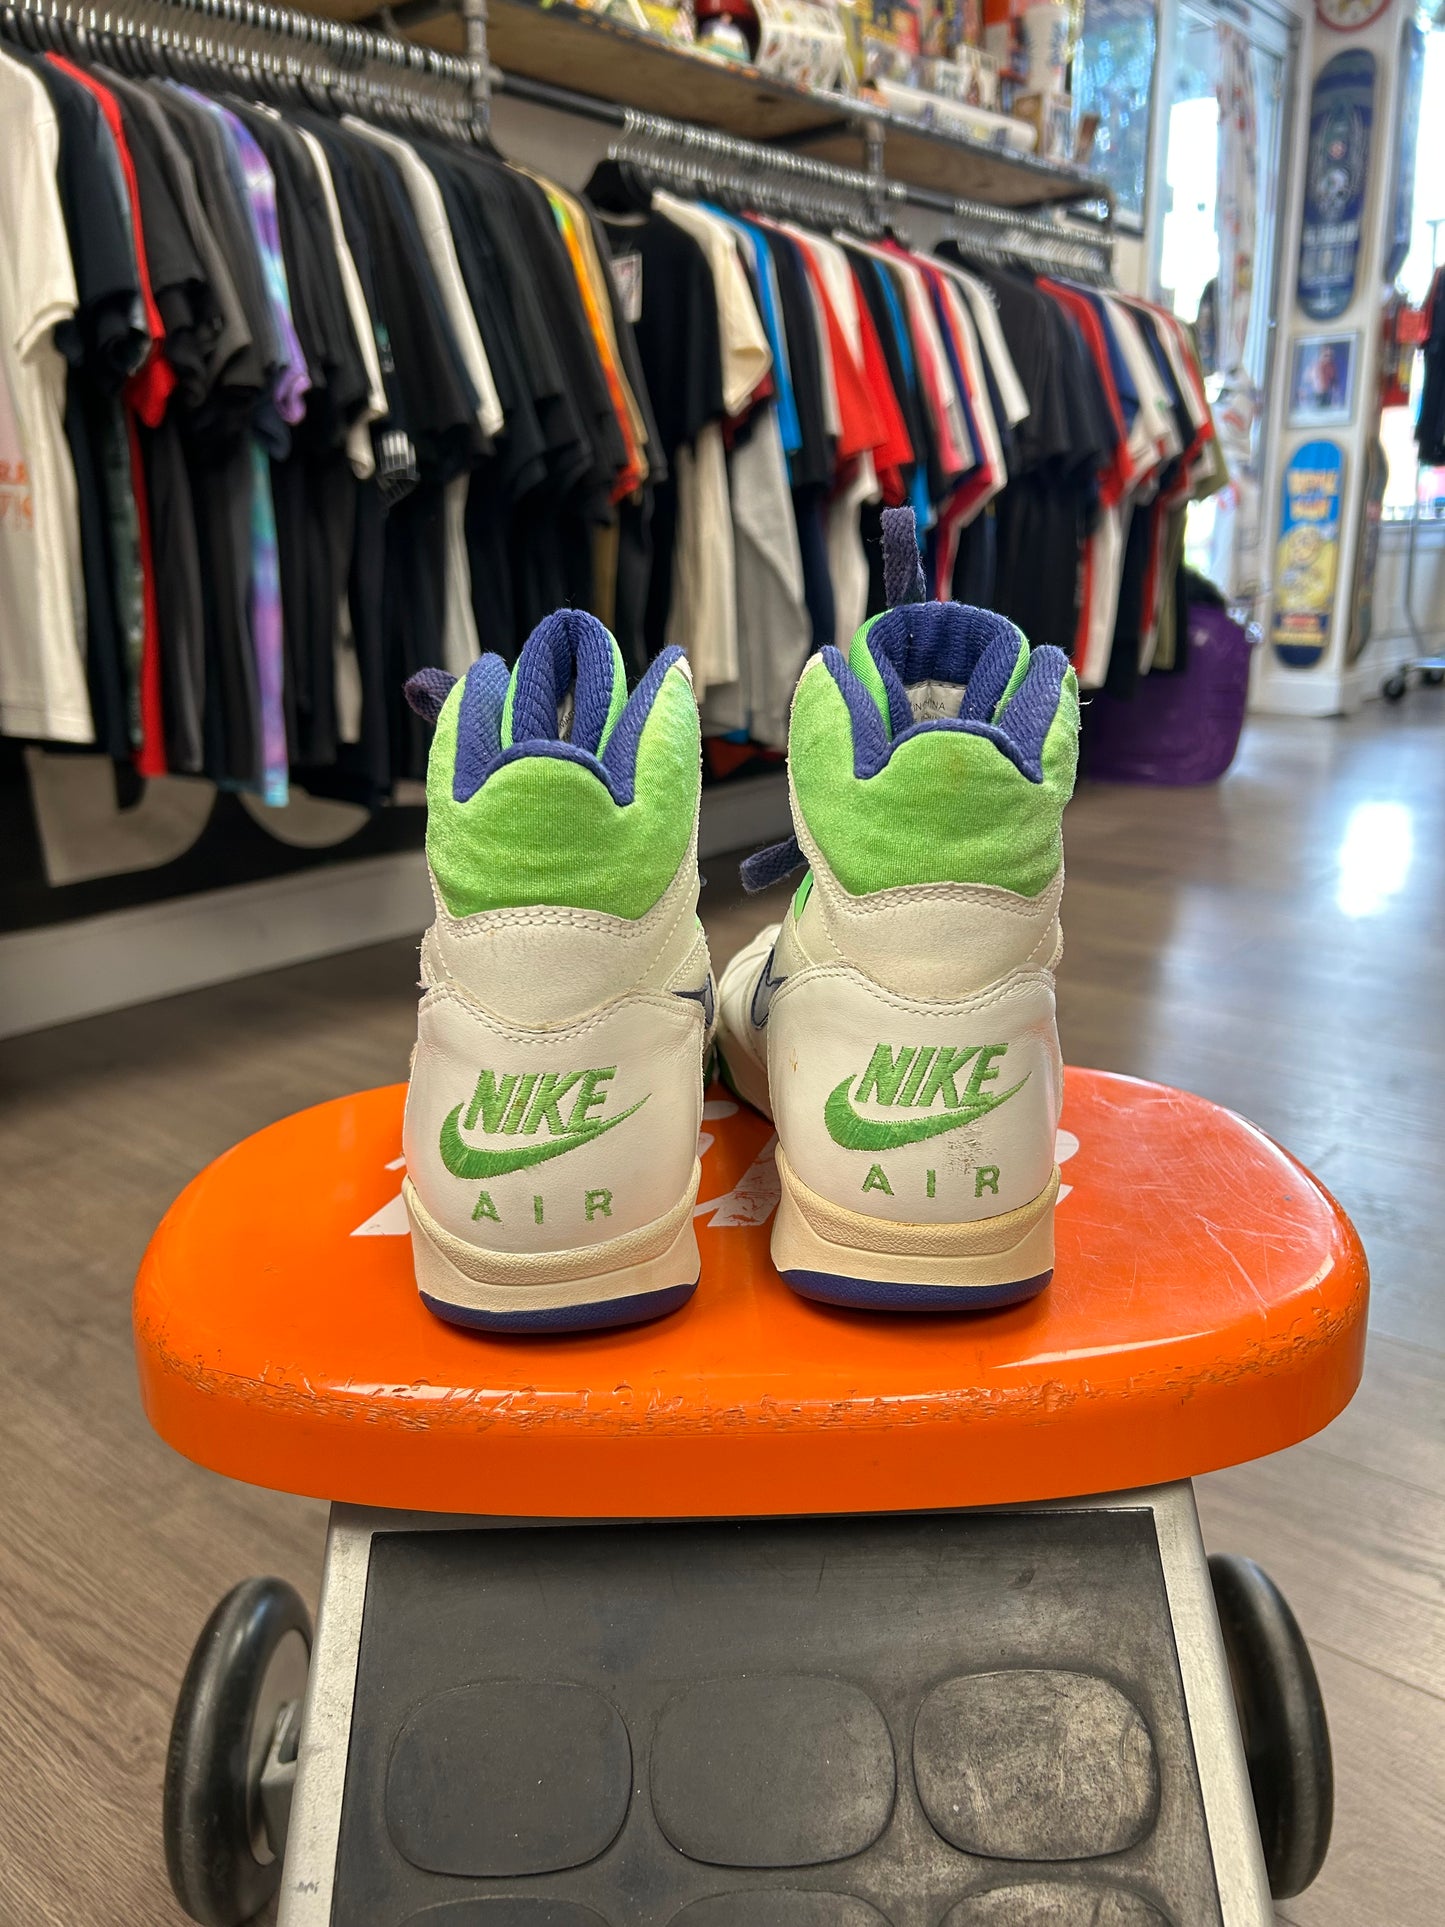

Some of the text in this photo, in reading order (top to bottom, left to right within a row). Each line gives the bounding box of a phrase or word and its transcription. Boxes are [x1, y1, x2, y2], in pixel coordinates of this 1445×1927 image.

[463, 1065, 617, 1135] NIKE
[854, 1042, 1009, 1108] NIKE
[861, 1163, 1000, 1198] AIR
[471, 1188, 613, 1225] AIR
